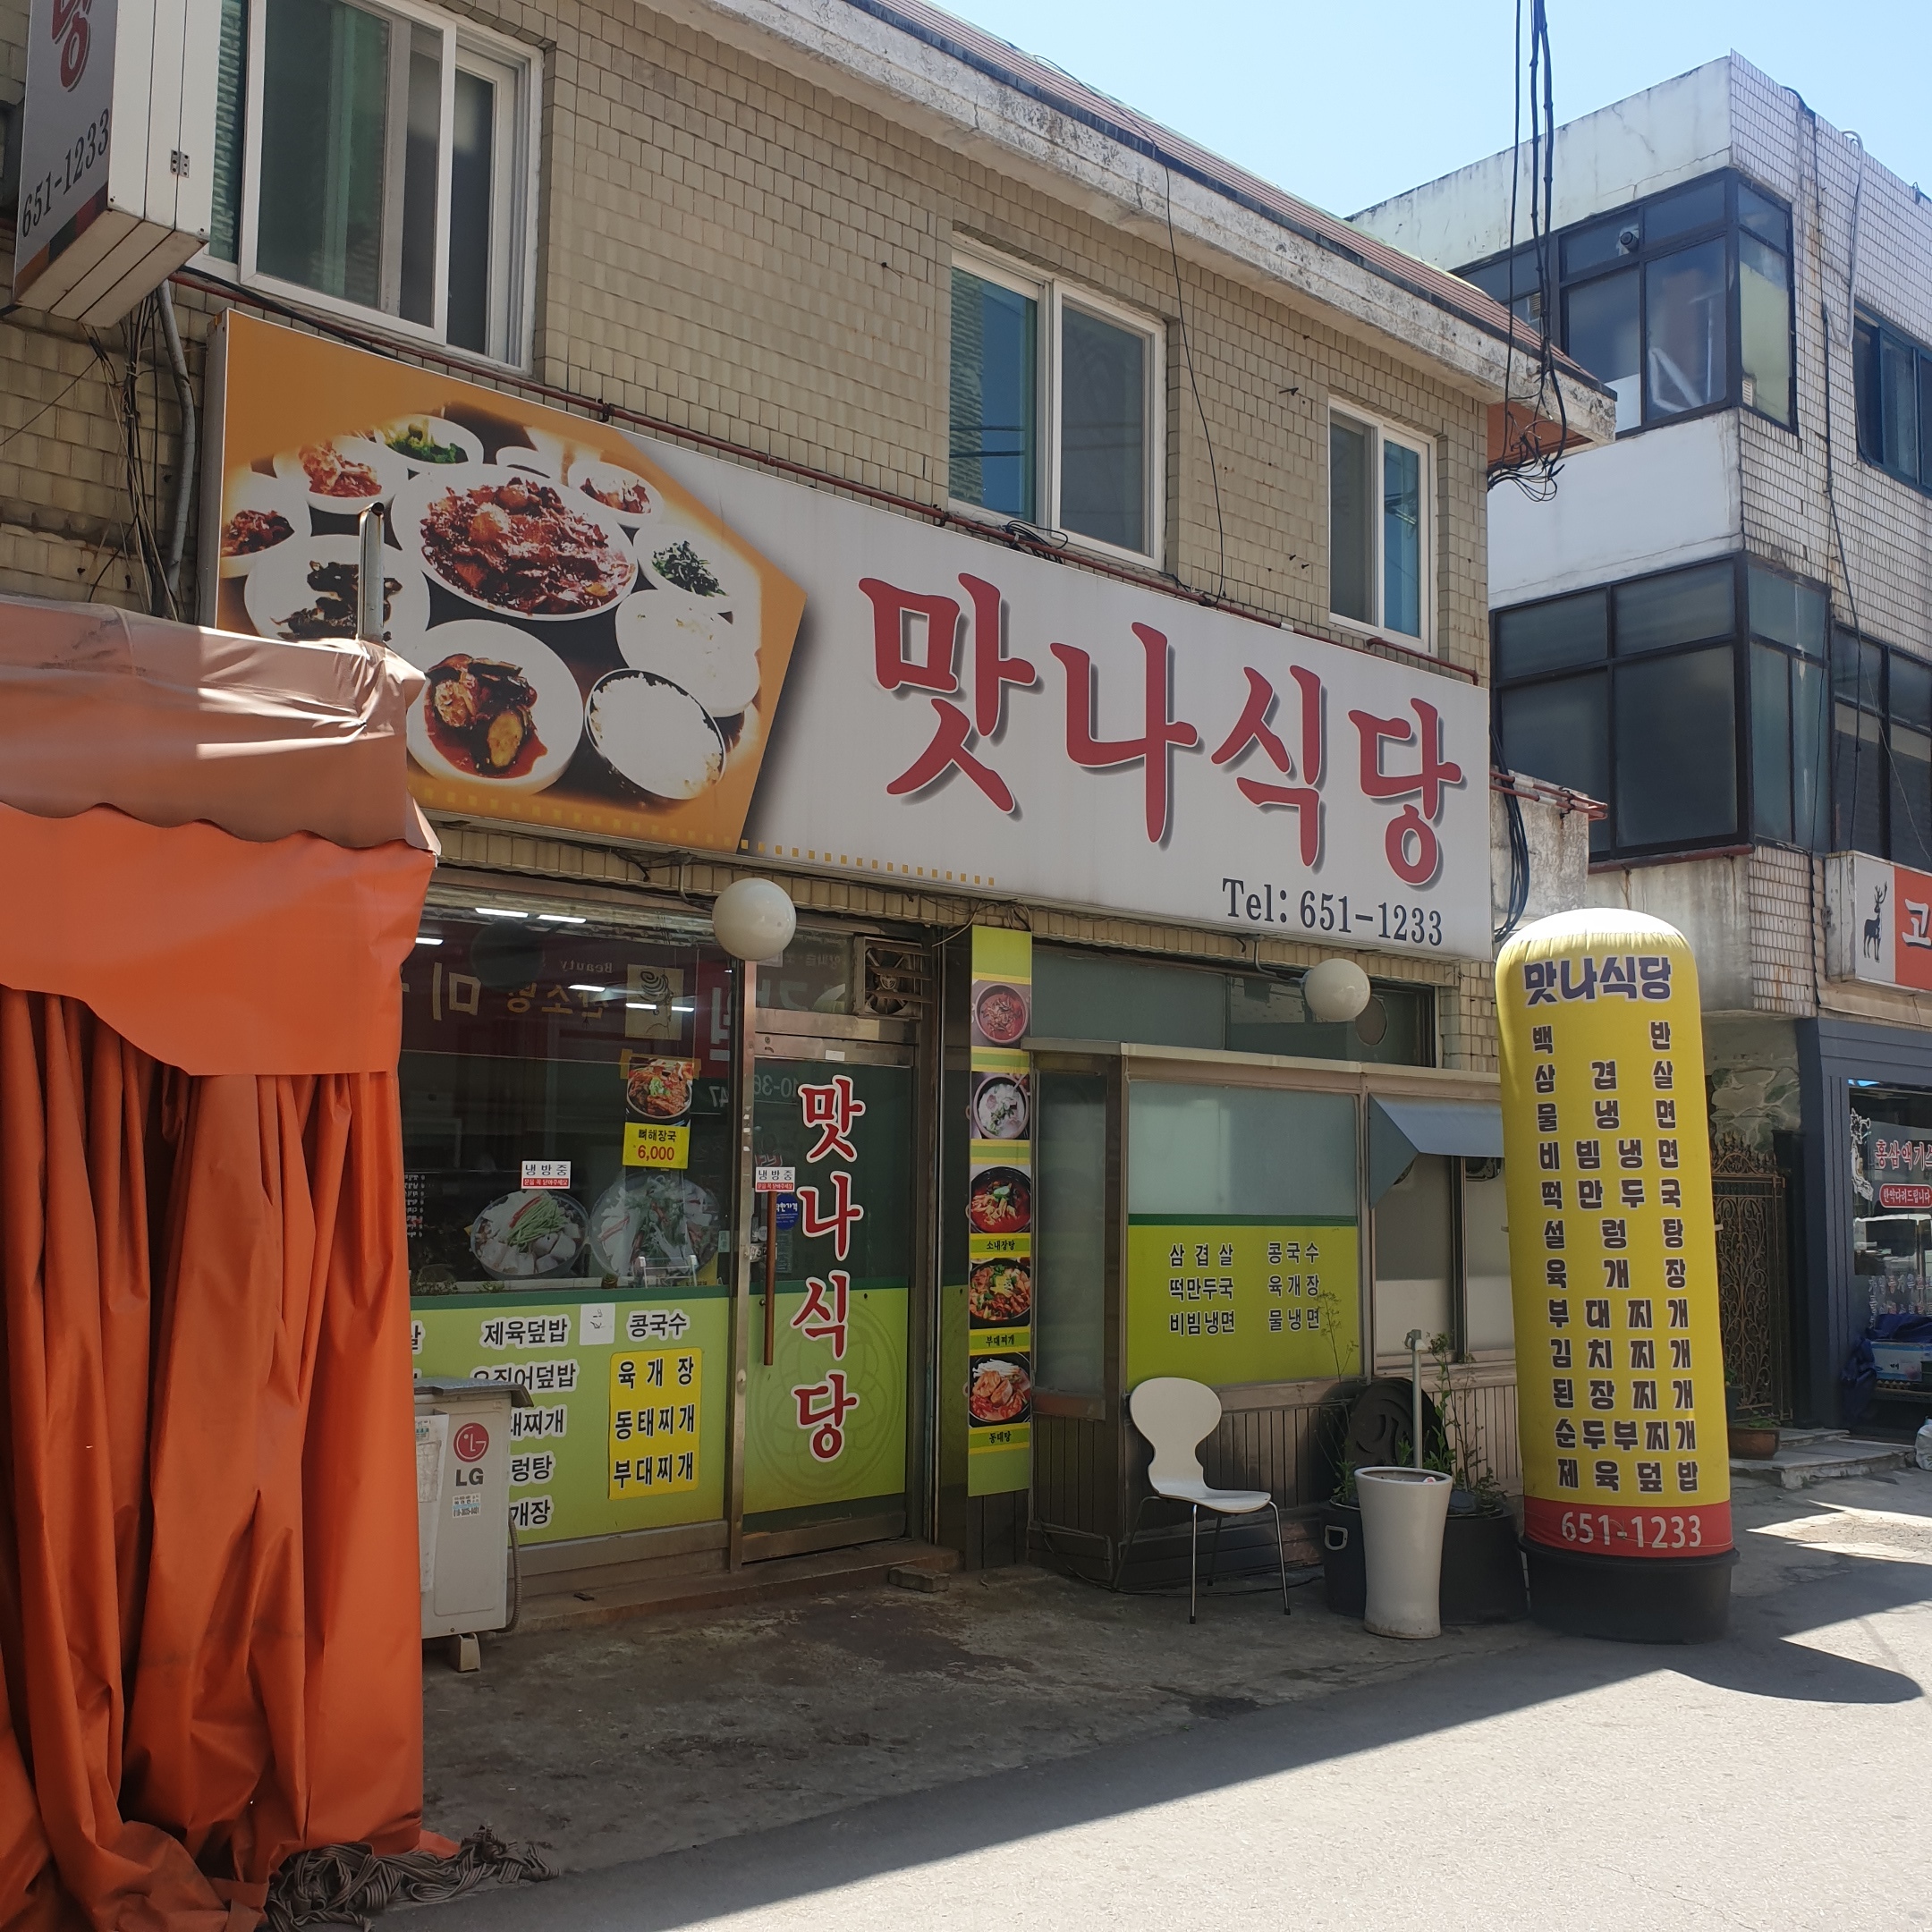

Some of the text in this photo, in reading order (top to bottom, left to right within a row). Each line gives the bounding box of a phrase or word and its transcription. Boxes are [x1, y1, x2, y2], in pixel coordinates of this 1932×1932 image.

[21, 107, 109, 238] 651-1233
[858, 572, 1462, 886] 맛나식당
[1222, 877, 1443, 946] Tel: 651-1233
[1523, 956, 1672, 1007] 맛나식당
[637, 1144, 675, 1162] 6,000
[791, 1076, 866, 1463] 맛나식당
[1170, 1277, 1233, 1301] 떡만두국
[484, 1318, 568, 1346] 제육덮밥
[629, 1312, 687, 1337] 콩국수
[1170, 1310, 1234, 1335] 비빔냉면
[614, 1404, 695, 1440] 동태찌개
[455, 1467, 484, 1487] LG
[512, 1454, 553, 1482] 렁탕
[614, 1452, 693, 1488] 부대찌개
[510, 1499, 551, 1526] 개장
[1562, 1511, 1702, 1549] 651-1233
